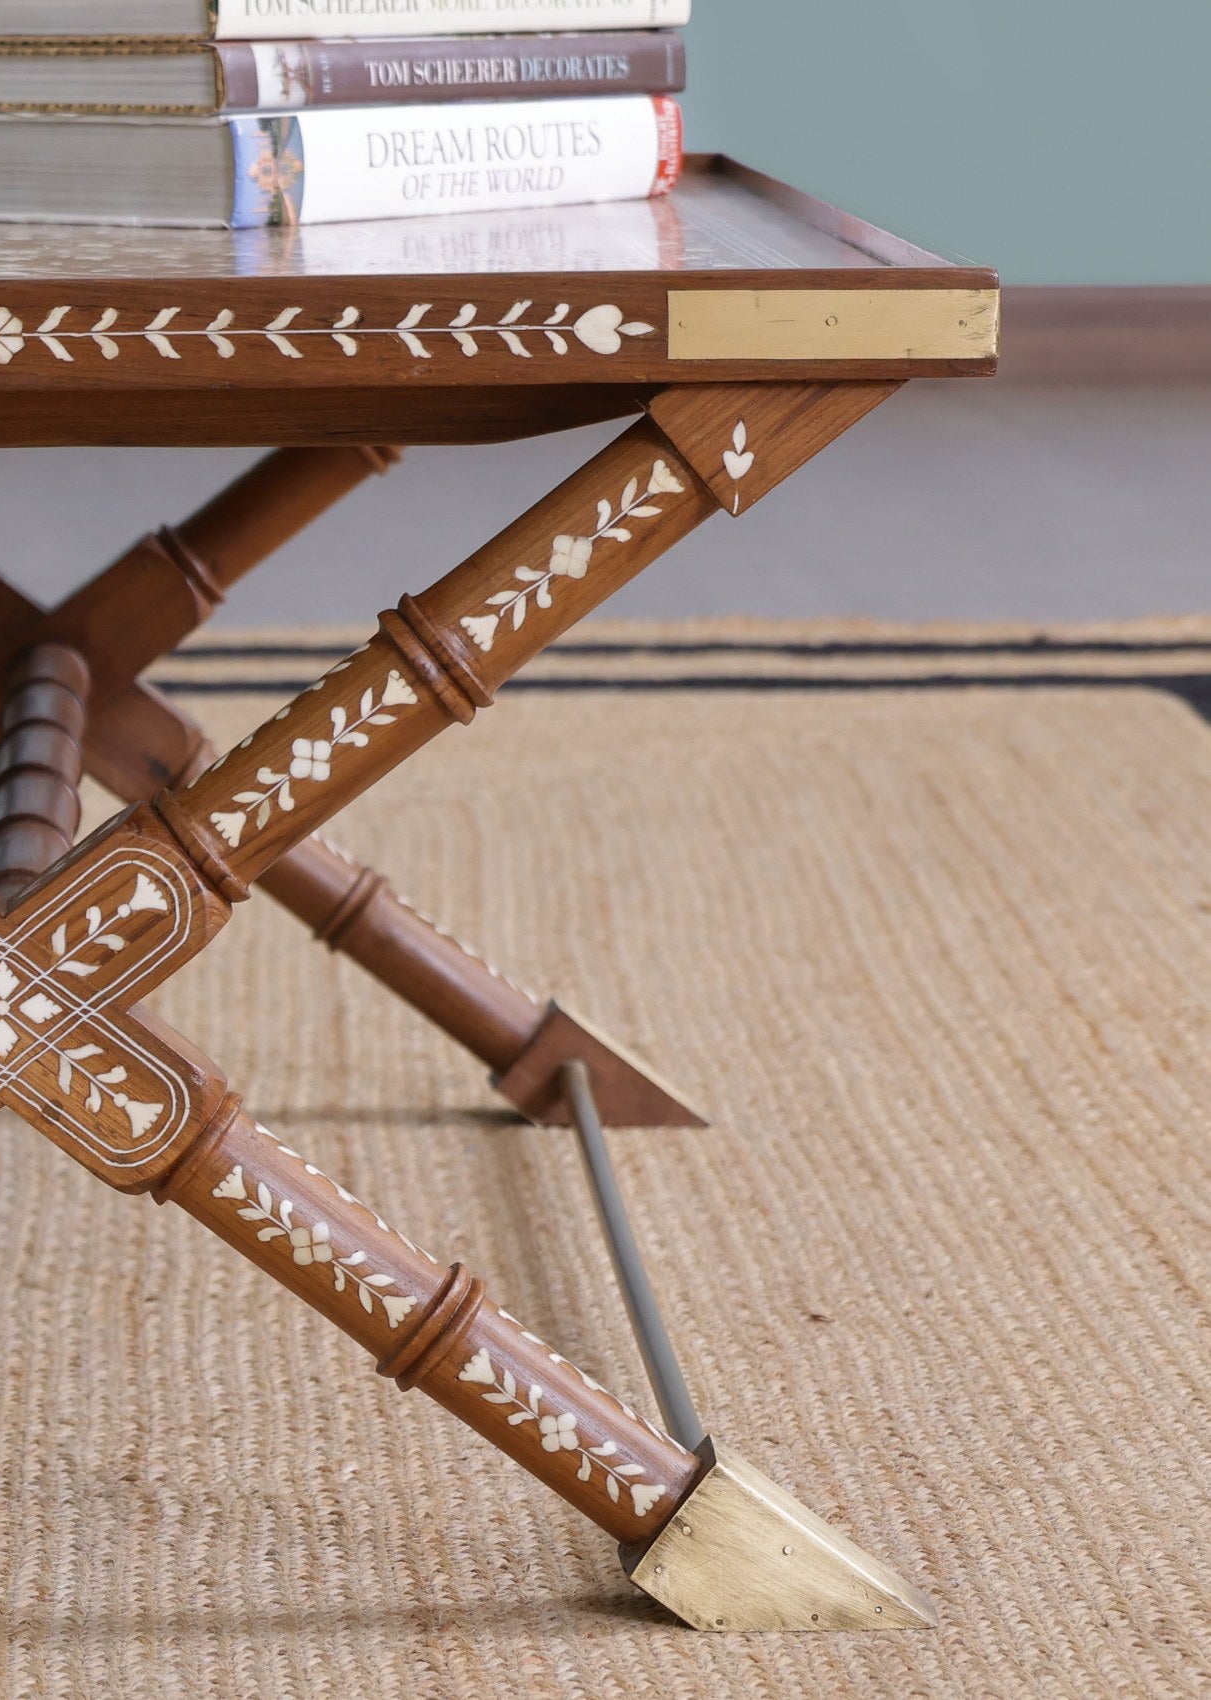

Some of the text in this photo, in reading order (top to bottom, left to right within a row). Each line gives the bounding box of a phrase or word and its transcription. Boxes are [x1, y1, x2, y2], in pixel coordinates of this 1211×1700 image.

[364, 59, 410, 87] TOM
[412, 57, 517, 86] SCHEERER
[518, 54, 630, 82] DECORATES
[366, 120, 601, 169] DREAM ROUTES
[401, 165, 564, 201] OF THE WORLD
